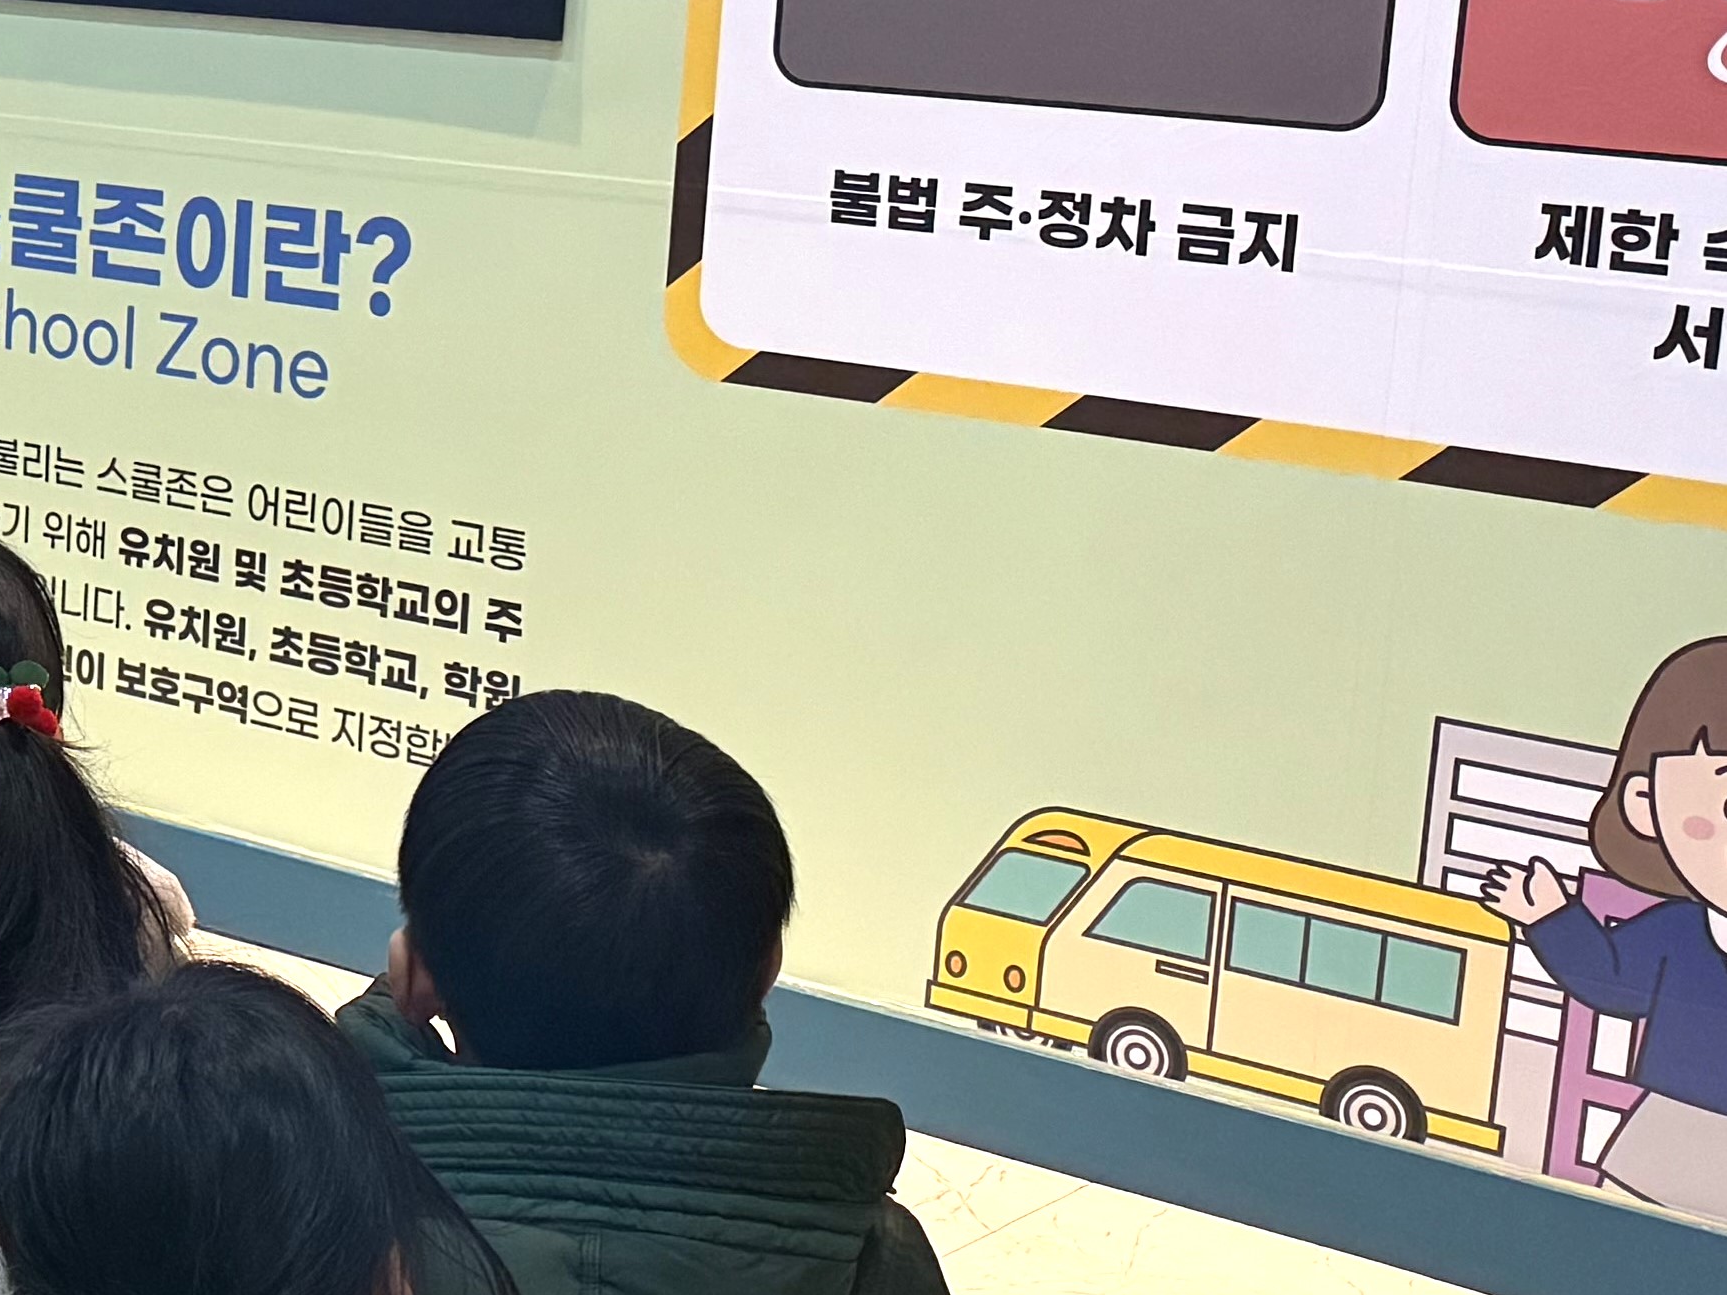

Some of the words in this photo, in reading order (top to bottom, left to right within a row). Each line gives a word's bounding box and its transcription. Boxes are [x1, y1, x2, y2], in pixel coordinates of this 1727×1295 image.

[828, 167, 939, 234] 불법
[959, 181, 1157, 258] 주·정차
[1175, 202, 1302, 273] 금지
[1534, 202, 1680, 276] 제한
[155, 314, 330, 399] Zone
[96, 456, 234, 517] 스쿨존은
[248, 483, 434, 555] 어린이들을
[447, 519, 526, 571] 교통
[42, 511, 107, 560] 위해
[118, 526, 221, 583] 유치원
[234, 547, 267, 592] 및
[280, 558, 470, 634] 초등학교의
[484, 597, 523, 644] 주
[51, 576, 132, 631] 니다.
[143, 598, 257, 662] 유치원,
[269, 625, 429, 700] 초등학교,
[115, 656, 320, 741] 보호구역으로
[332, 706, 452, 769] 지정합
